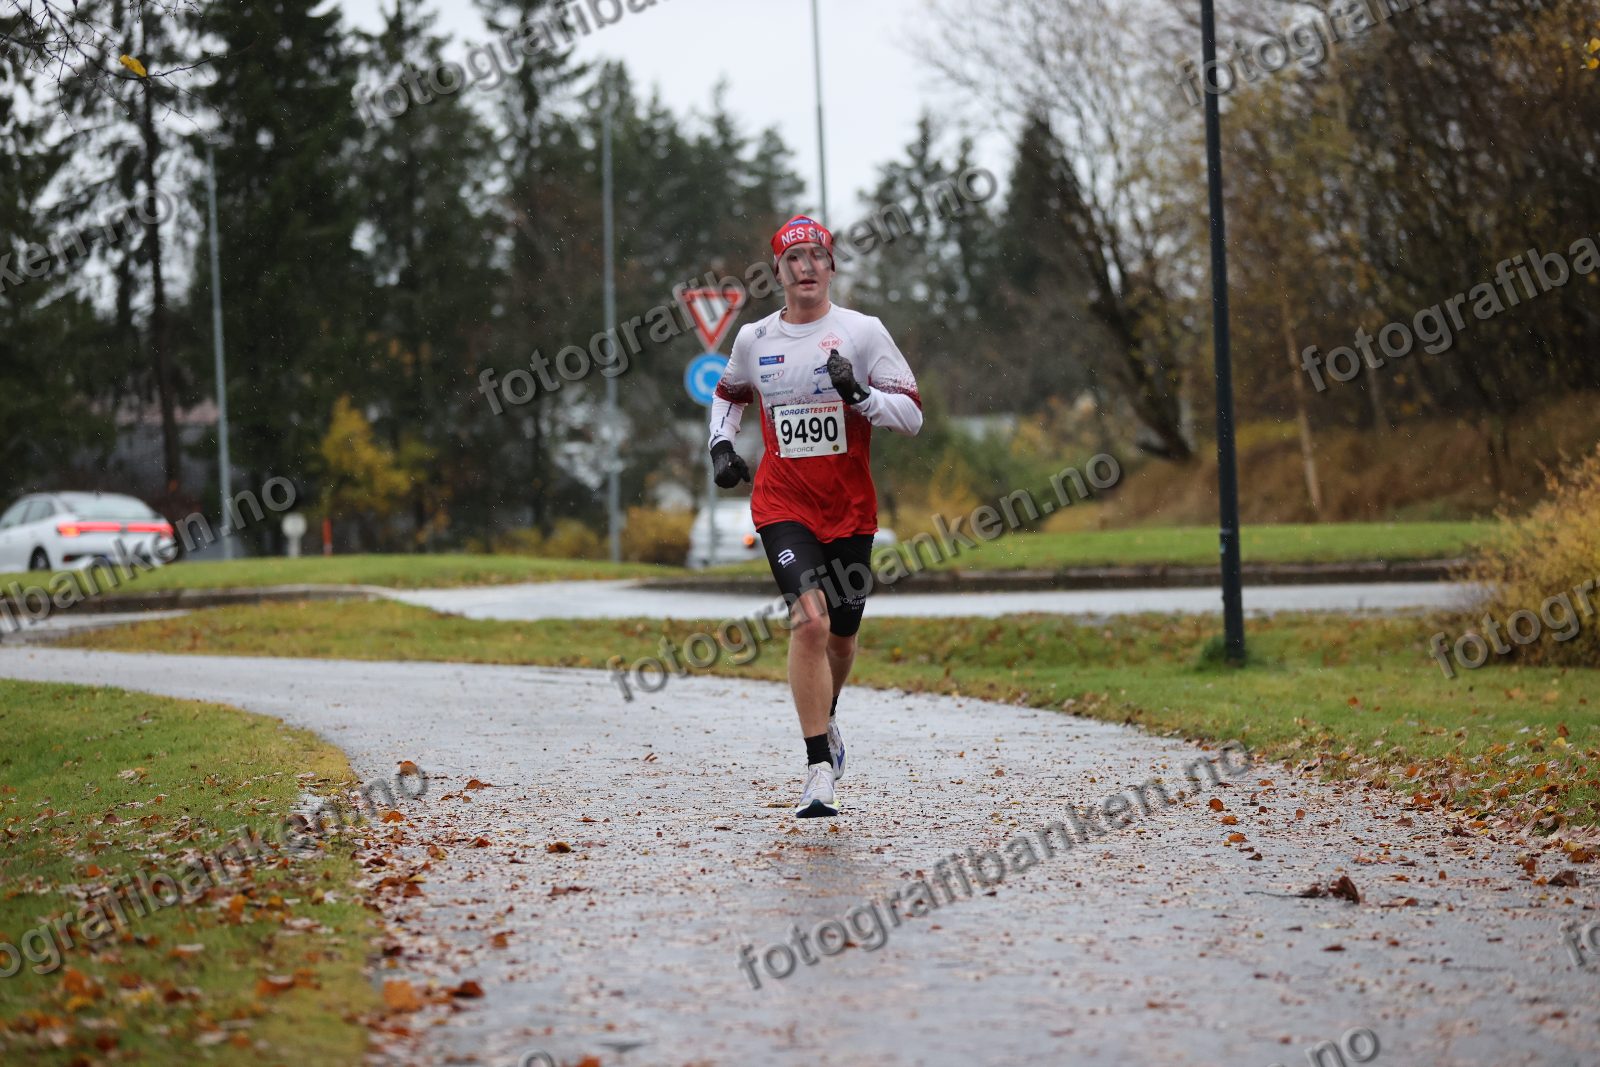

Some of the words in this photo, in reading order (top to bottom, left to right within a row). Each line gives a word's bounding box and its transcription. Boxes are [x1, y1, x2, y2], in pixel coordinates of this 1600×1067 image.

[781, 227, 805, 246] NES
[808, 227, 826, 244] SKI
[780, 406, 838, 416] NORGESTESTEN
[780, 416, 838, 445] 9490
